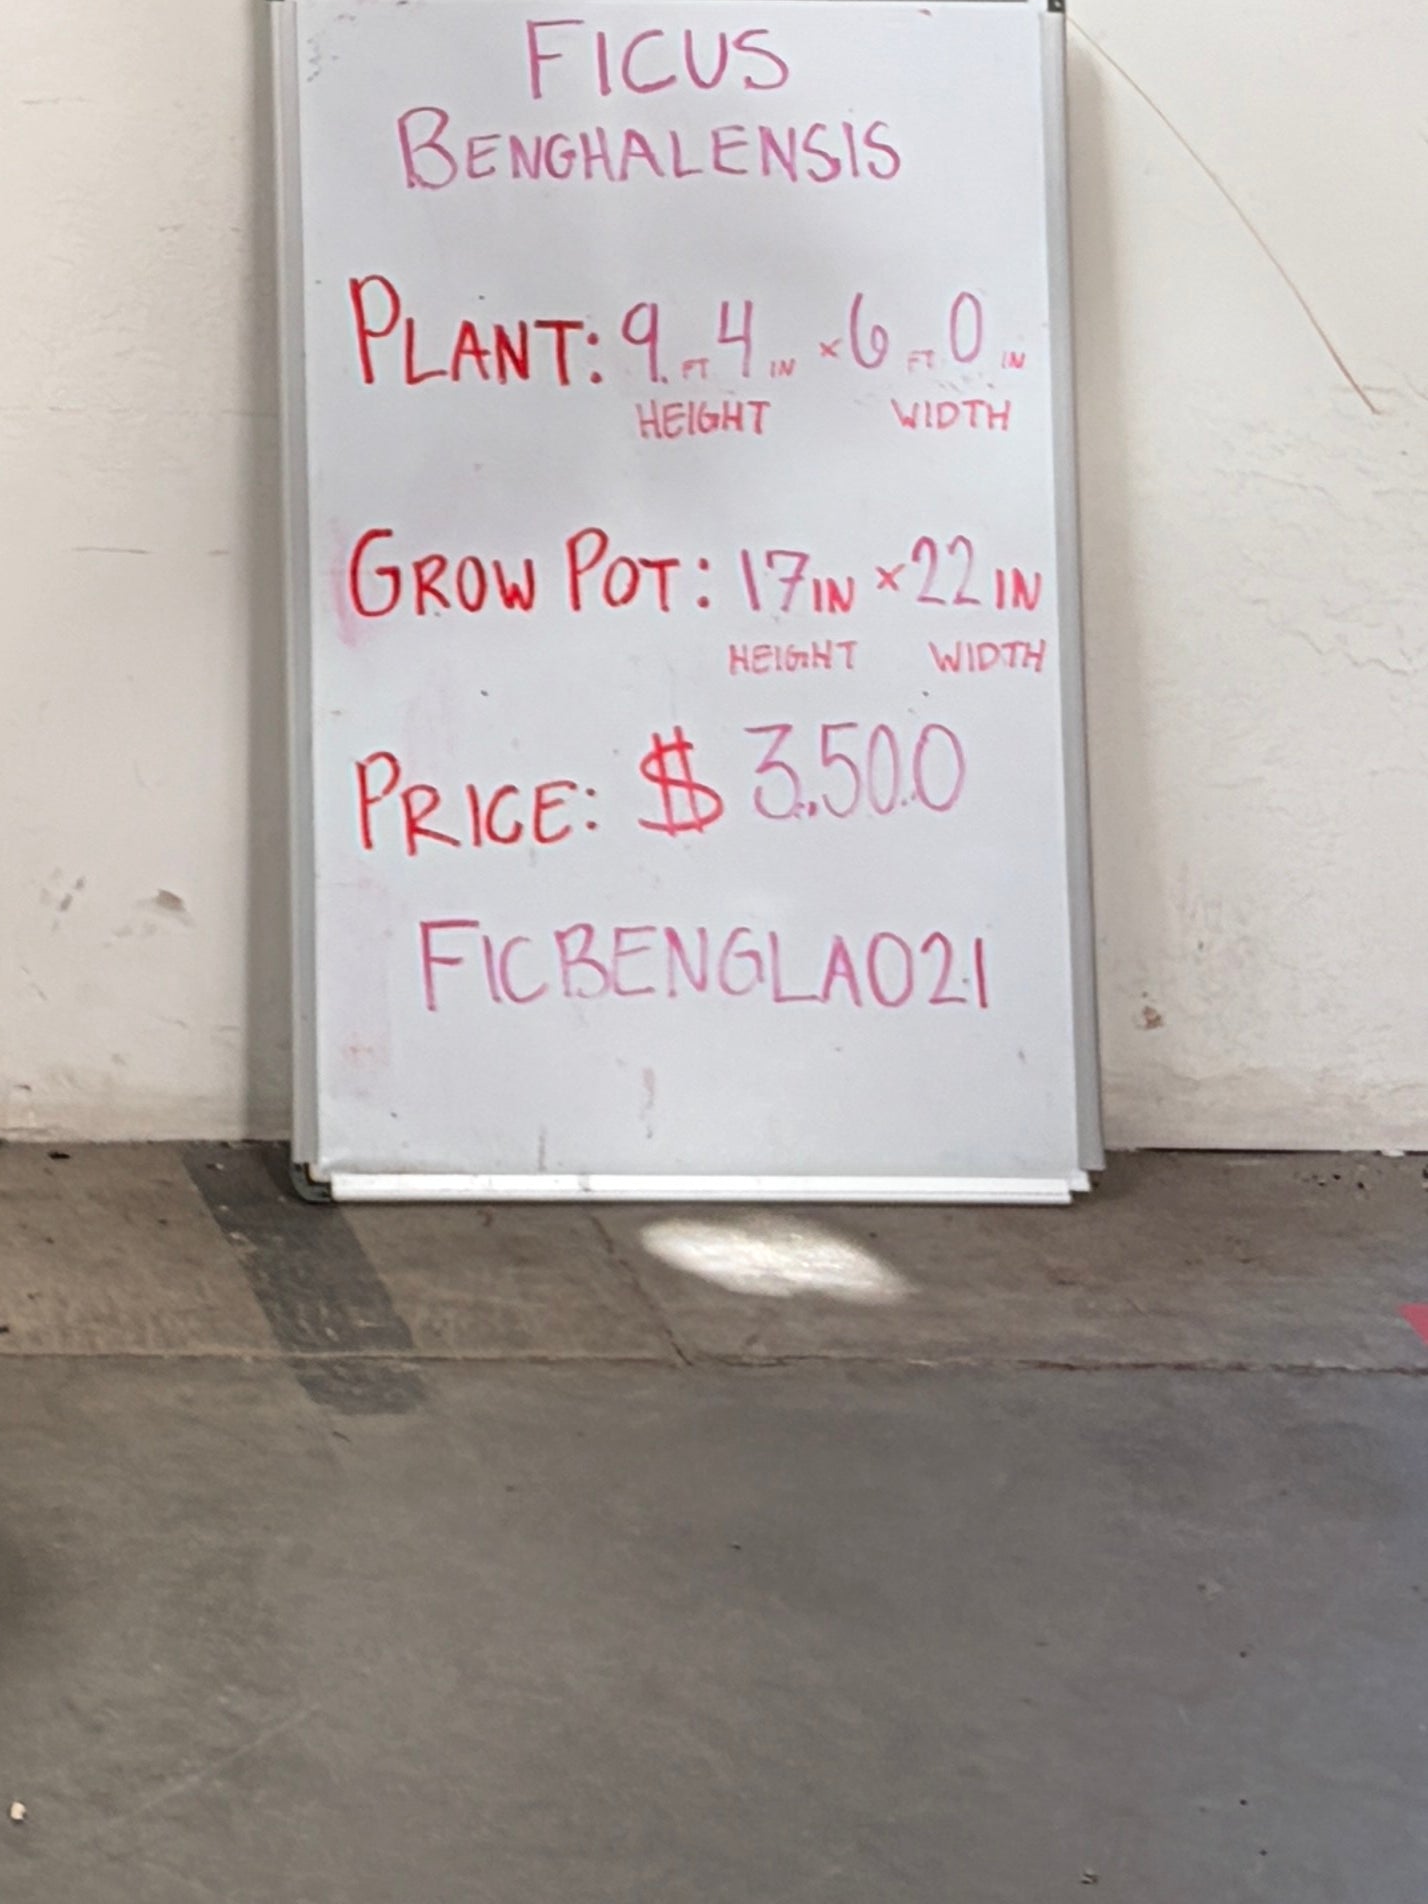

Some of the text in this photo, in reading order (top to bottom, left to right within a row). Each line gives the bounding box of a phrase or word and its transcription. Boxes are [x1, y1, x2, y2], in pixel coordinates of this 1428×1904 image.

[526, 18, 790, 99] FICUS
[397, 106, 902, 190] BENGHALENSIS
[349, 274, 604, 387] PLANT:
[718, 300, 753, 378] 4
[849, 292, 890, 370] 6
[636, 398, 1012, 439] HEIGHT WIDTH
[349, 529, 536, 617] GROW
[565, 528, 710, 614] POT:
[729, 640, 1046, 675] HEIGHT WIDTH
[354, 752, 599, 857] PRICE:
[418, 920, 988, 1013] FICBENGLA021
